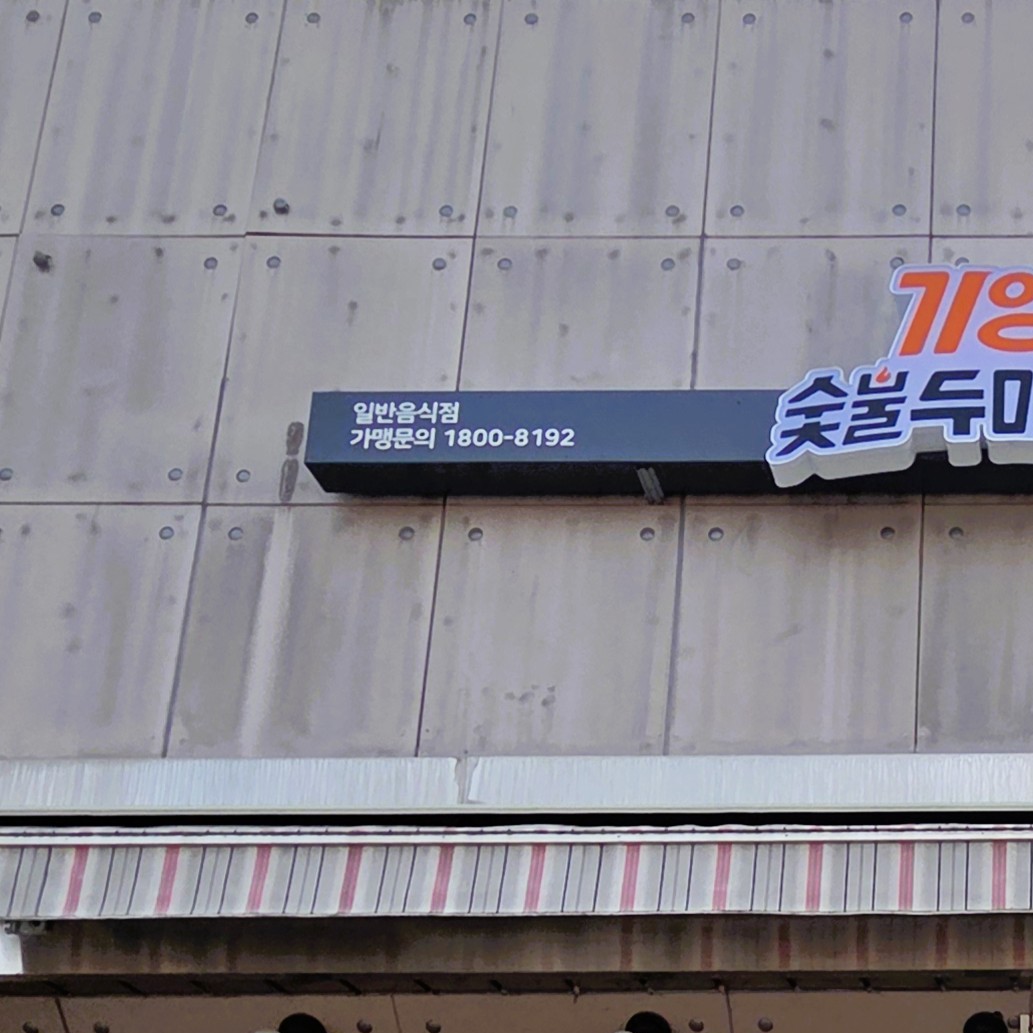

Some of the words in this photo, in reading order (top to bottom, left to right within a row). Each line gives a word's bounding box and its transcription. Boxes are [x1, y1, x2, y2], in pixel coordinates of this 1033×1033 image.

[353, 401, 460, 424] 일반음식점
[350, 427, 436, 449] 가맹문의
[444, 428, 576, 447] 1800-8192
